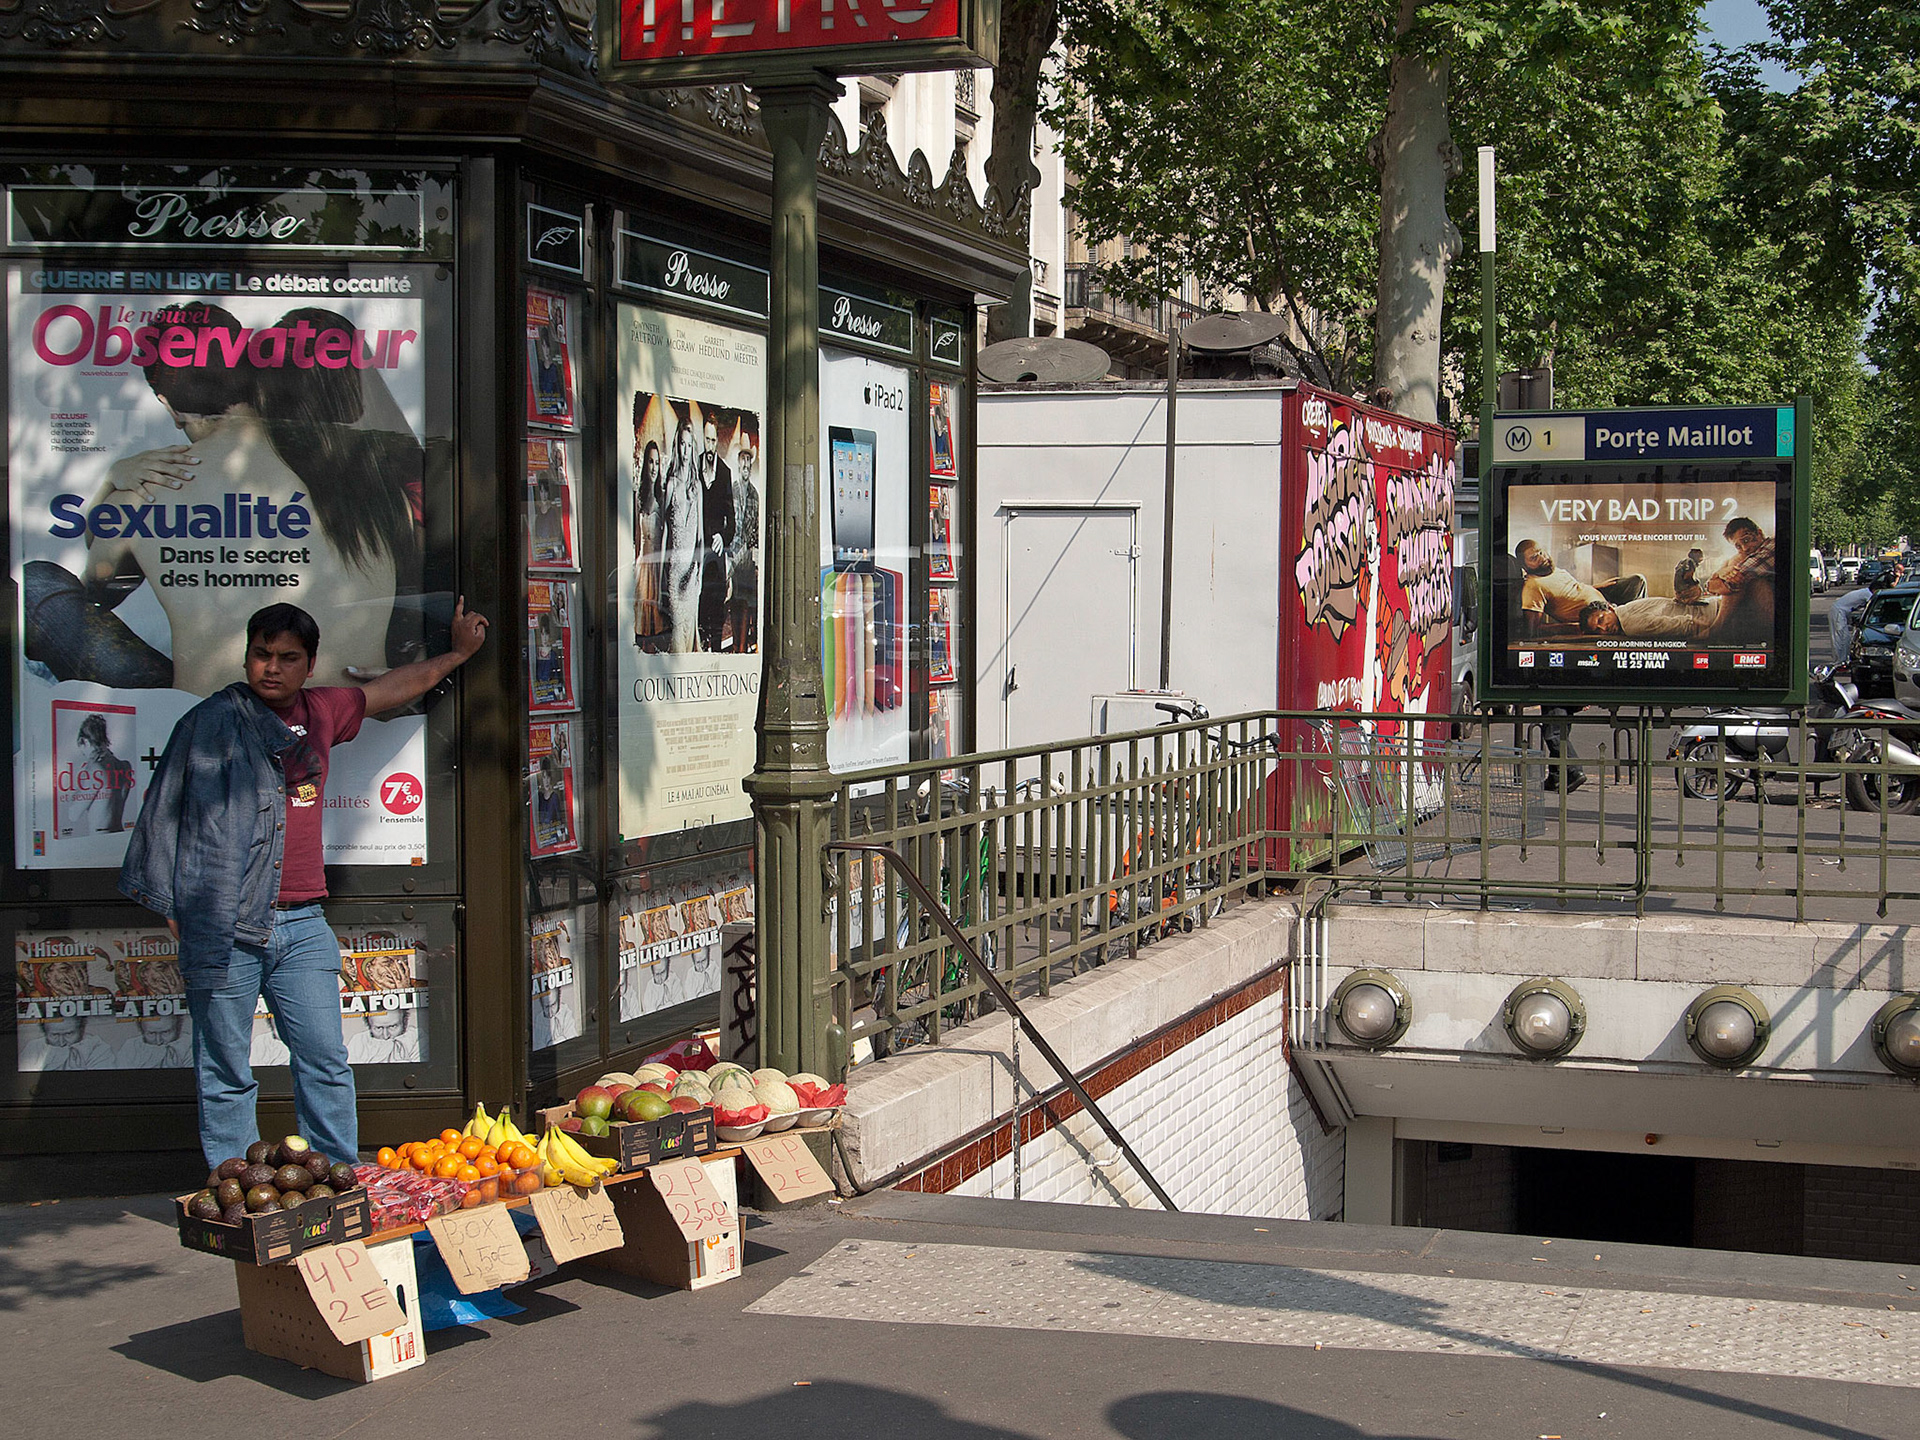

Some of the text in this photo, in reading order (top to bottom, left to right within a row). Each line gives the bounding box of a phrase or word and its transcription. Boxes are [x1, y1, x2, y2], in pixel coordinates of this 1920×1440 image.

[127, 192, 306, 239] Presse
[30, 270, 412, 294] GUERRE EN LIBYE Le débat occulté
[663, 250, 731, 301] Presse
[117, 305, 211, 324] le nouvel
[831, 296, 882, 338] Presse
[31, 304, 418, 369] Observateur
[631, 330, 664, 347] PALTROW
[704, 335, 725, 347] GARRETT
[698, 344, 730, 361] HEDLUND
[734, 352, 759, 366] MEESTER
[874, 383, 896, 410] iPad
[898, 389, 904, 411] 2
[62, 428, 95, 438] l'enquête
[1543, 431, 1552, 446] 1
[1595, 424, 1753, 450] Porte Maillot
[51, 445, 79, 453] Philippe
[48, 491, 311, 540] Sexualité
[1540, 497, 1738, 523] VERY BAD TRIP 2
[1578, 534, 1599, 542] VOUS
[1601, 534, 1626, 542] N'AVEZ
[160, 546, 311, 564] Dans le secret
[159, 570, 300, 588] des hommes
[1596, 640, 1687, 648] GOOD MORNING BANGKOK
[1613, 652, 1670, 661] AU CINEMA
[1617, 660, 1666, 669] LE 25 MAI
[1696, 657, 1709, 665] SFR
[1739, 655, 1760, 665] RMC
[633, 672, 759, 703] COUNTRY STRONG
[58, 762, 136, 793] désirs
[667, 783, 730, 803] LE 4 MAI AU CINÉMA
[326, 844, 358, 852] disponible
[384, 843, 396, 852] prix
[640, 949, 652, 965] LA
[653, 940, 680, 960] FOLIE
[681, 938, 693, 953] LA
[693, 929, 719, 948] FOLIE
[541, 968, 573, 992] FOLIE
[17, 1000, 113, 1019] LA FOLIE
[340, 992, 429, 1013] LA FOLIE
[658, 1166, 703, 1197] 2 P
[772, 1173, 801, 1191] 2
[441, 1218, 498, 1248] BOX
[304, 1247, 360, 1293] 4 P
[329, 1299, 360, 1323] 2
